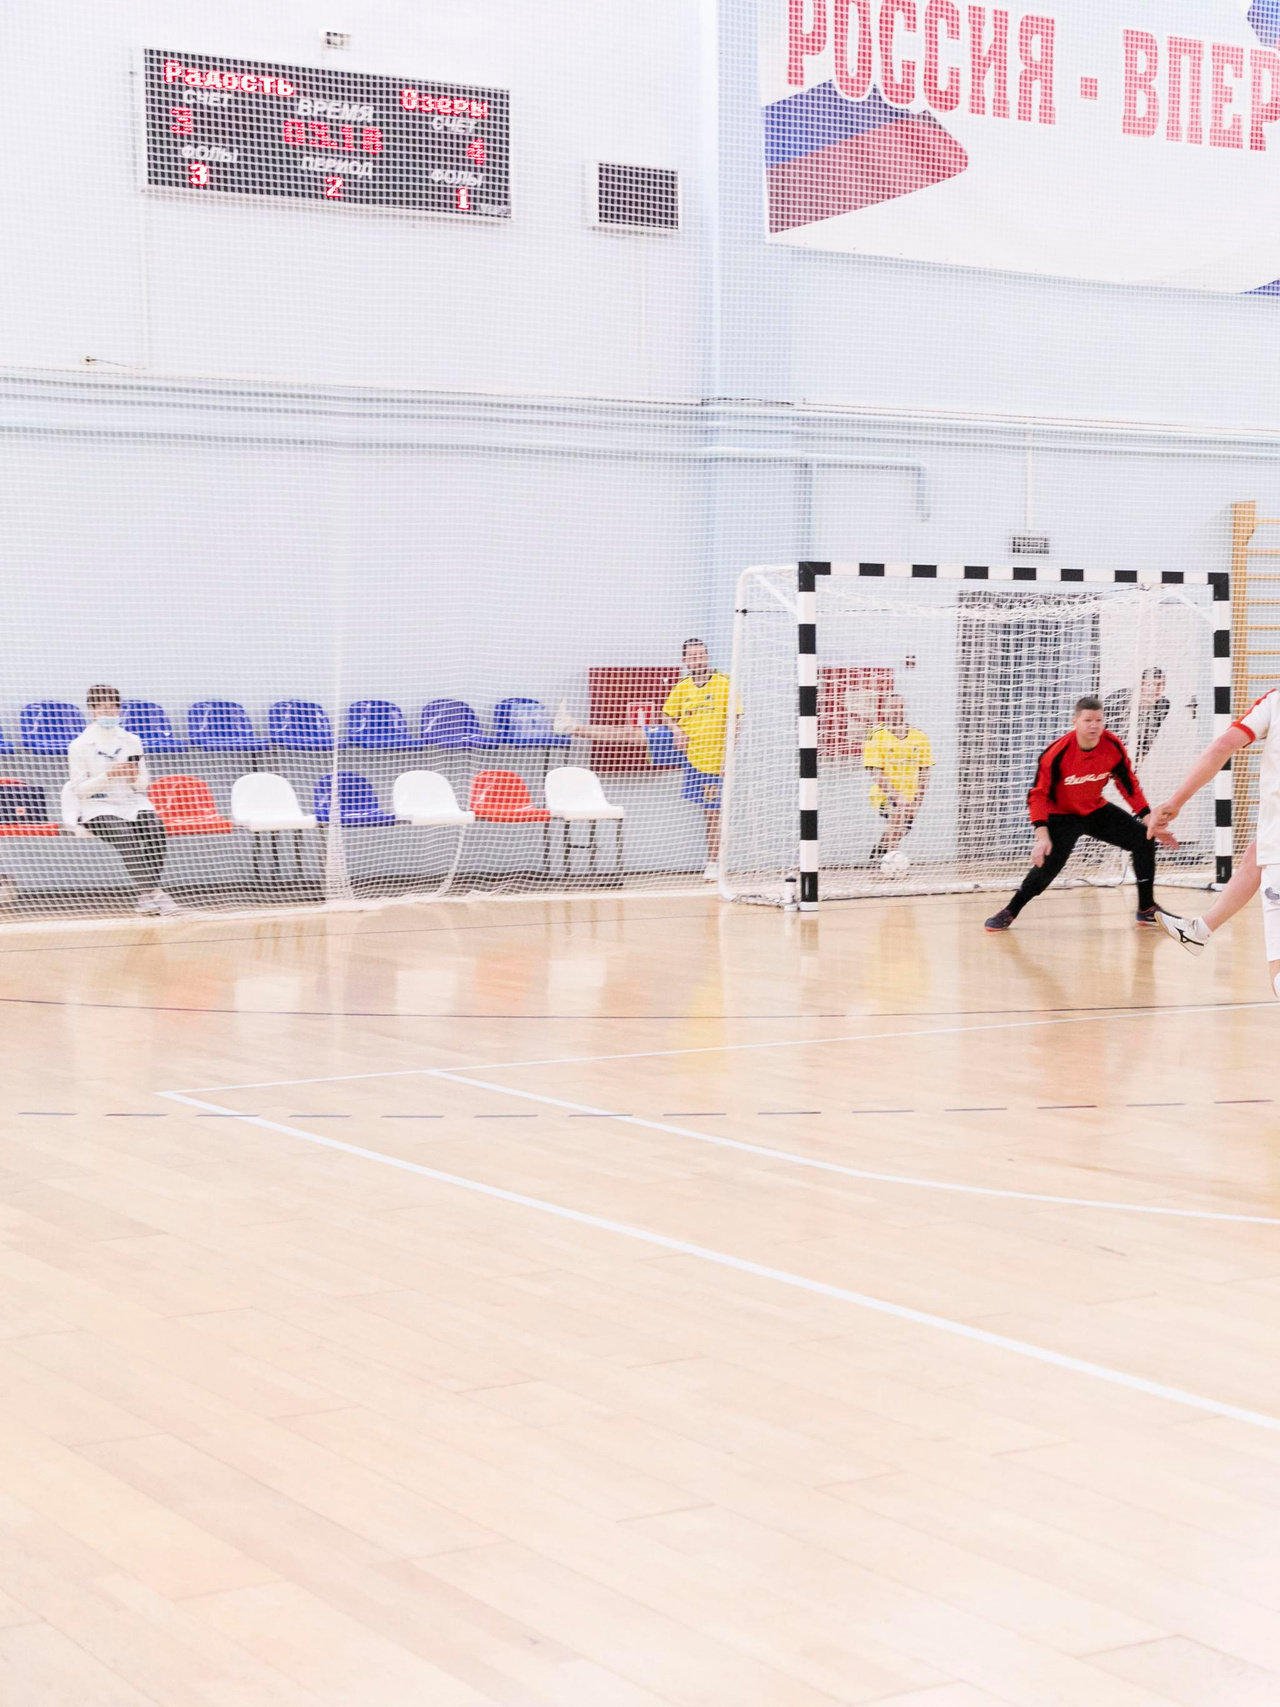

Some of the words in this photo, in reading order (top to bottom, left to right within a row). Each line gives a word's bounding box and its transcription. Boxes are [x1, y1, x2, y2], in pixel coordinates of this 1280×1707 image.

[788, 0, 1056, 126] РОССИЯ
[164, 60, 295, 97] Радость
[182, 89, 232, 107] СЧЕТ
[298, 98, 375, 123] ВРЕМЯ
[432, 115, 477, 135] СЧЕТ
[181, 145, 239, 163] ФОЛЫ
[188, 161, 210, 186] 3
[301, 155, 374, 180] ПЕРИОД
[325, 174, 344, 199] 2
[456, 186, 470, 210] 1
